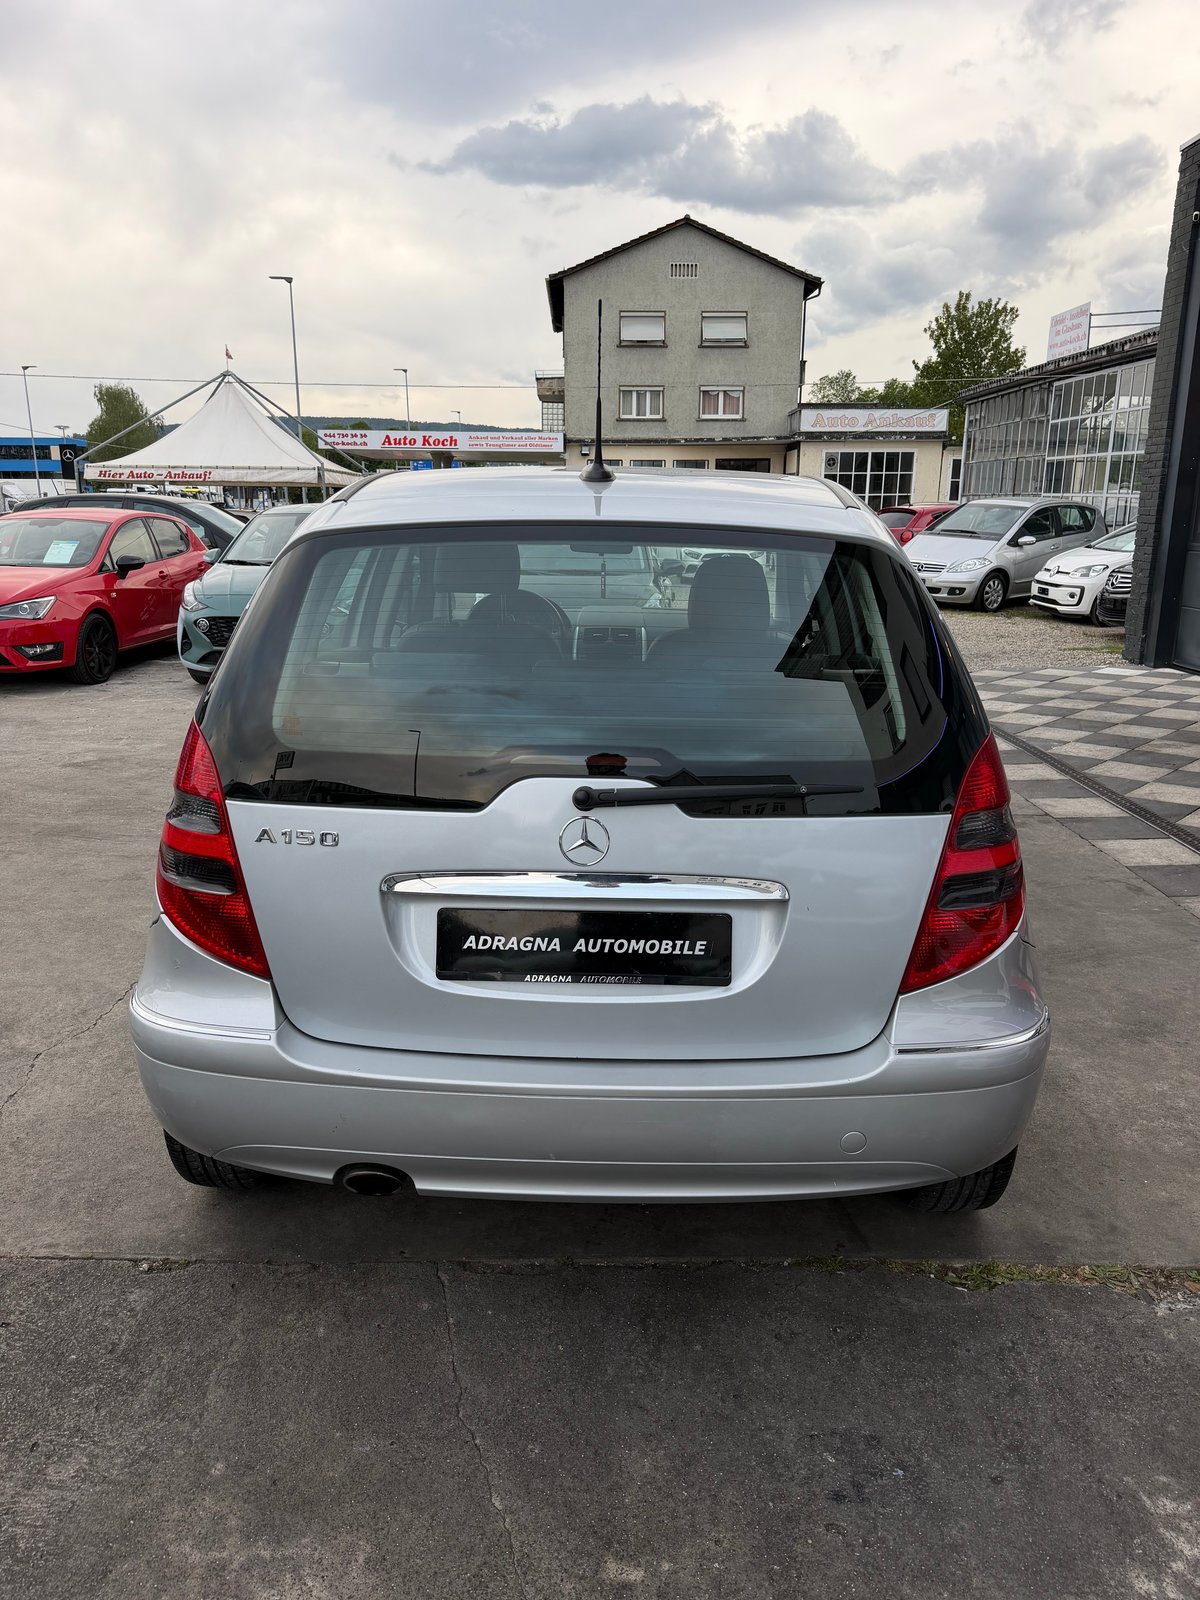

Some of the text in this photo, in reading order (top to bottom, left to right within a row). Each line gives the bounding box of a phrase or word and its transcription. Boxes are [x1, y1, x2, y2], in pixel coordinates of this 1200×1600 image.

[811, 413, 936, 428] Auto Ankauf
[381, 434, 458, 447] Auto Koch
[97, 469, 124, 479] Hier
[462, 934, 708, 956] ADRAGNA AUTOMOBILE
[524, 974, 643, 985] ADRAGNA AUTOMOBILE
